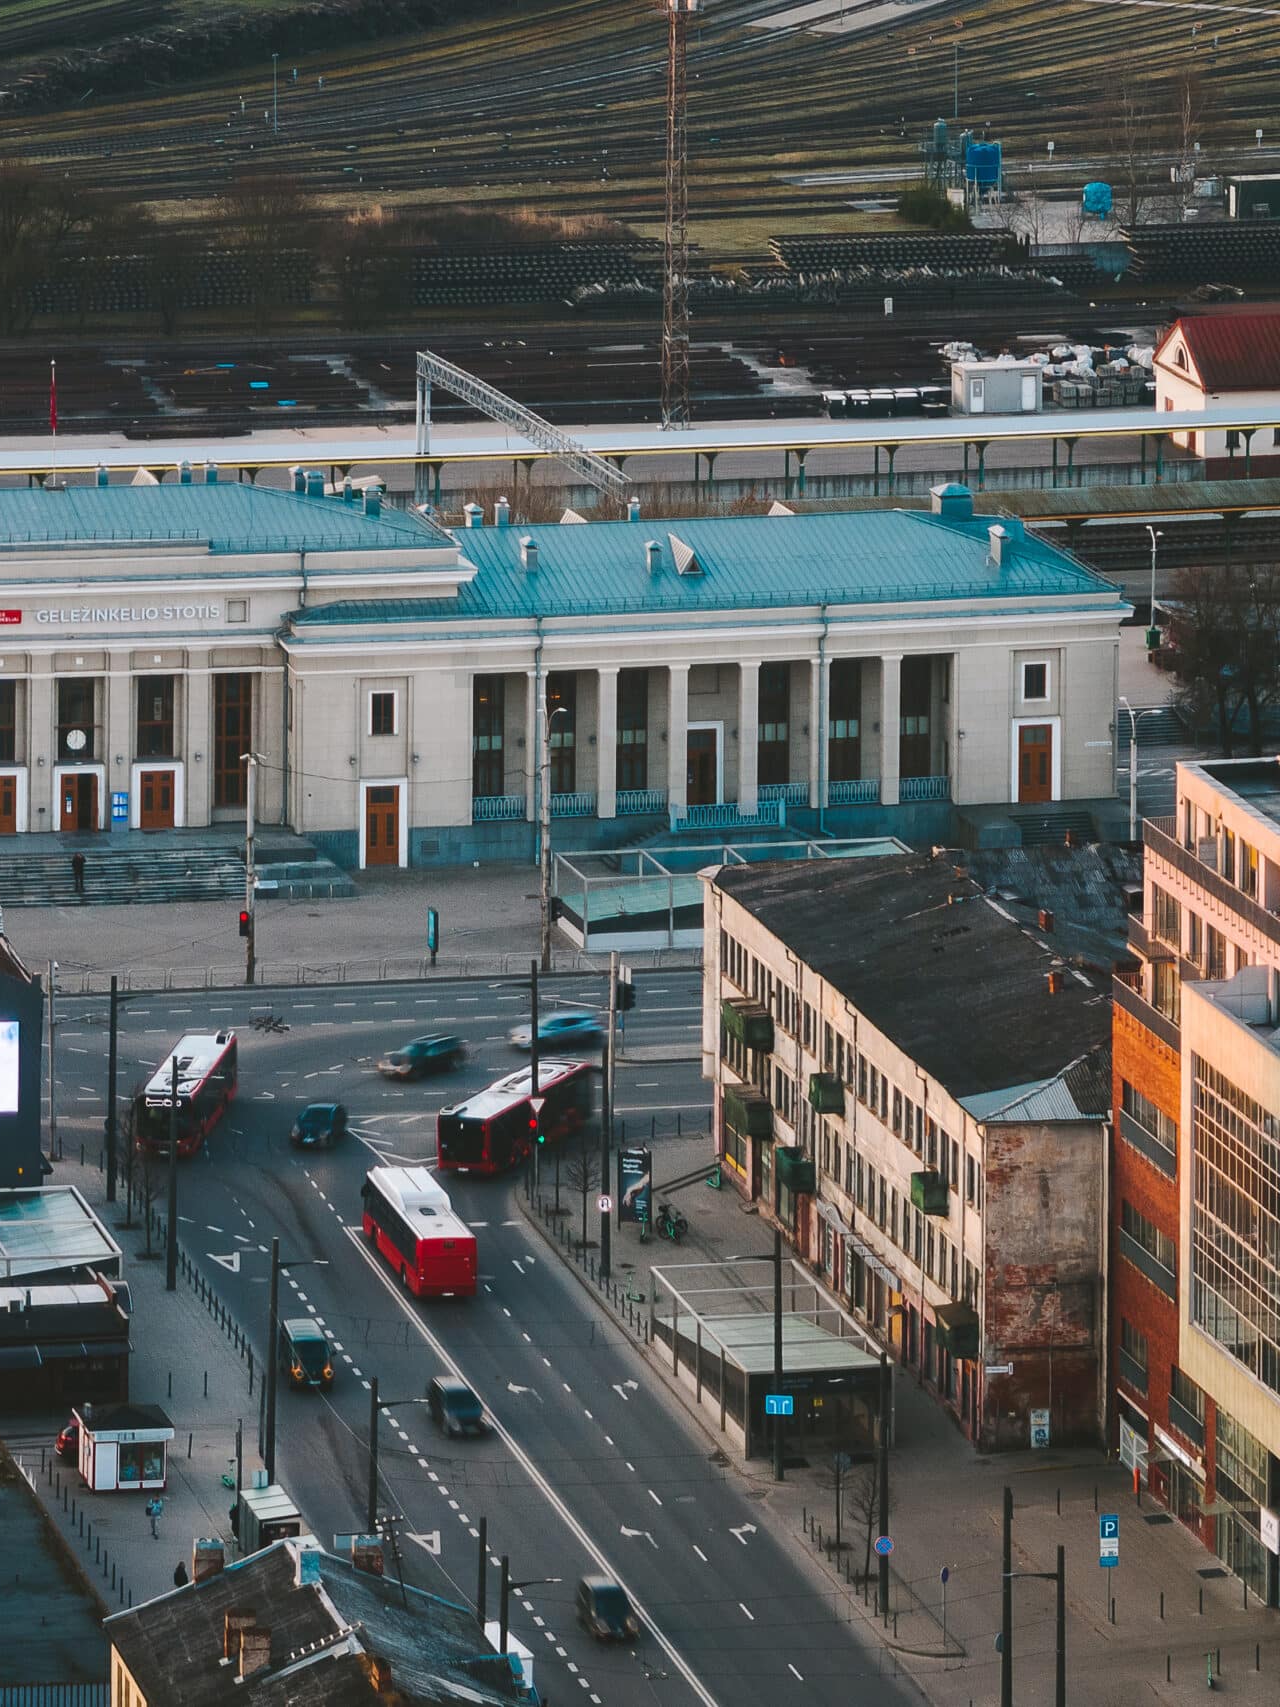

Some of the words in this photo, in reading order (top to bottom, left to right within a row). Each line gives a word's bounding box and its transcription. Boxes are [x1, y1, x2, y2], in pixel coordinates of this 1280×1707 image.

[36, 606, 158, 623] GELEŽINKELIO
[163, 605, 220, 619] STOTIS
[1105, 1521, 1115, 1537] P
